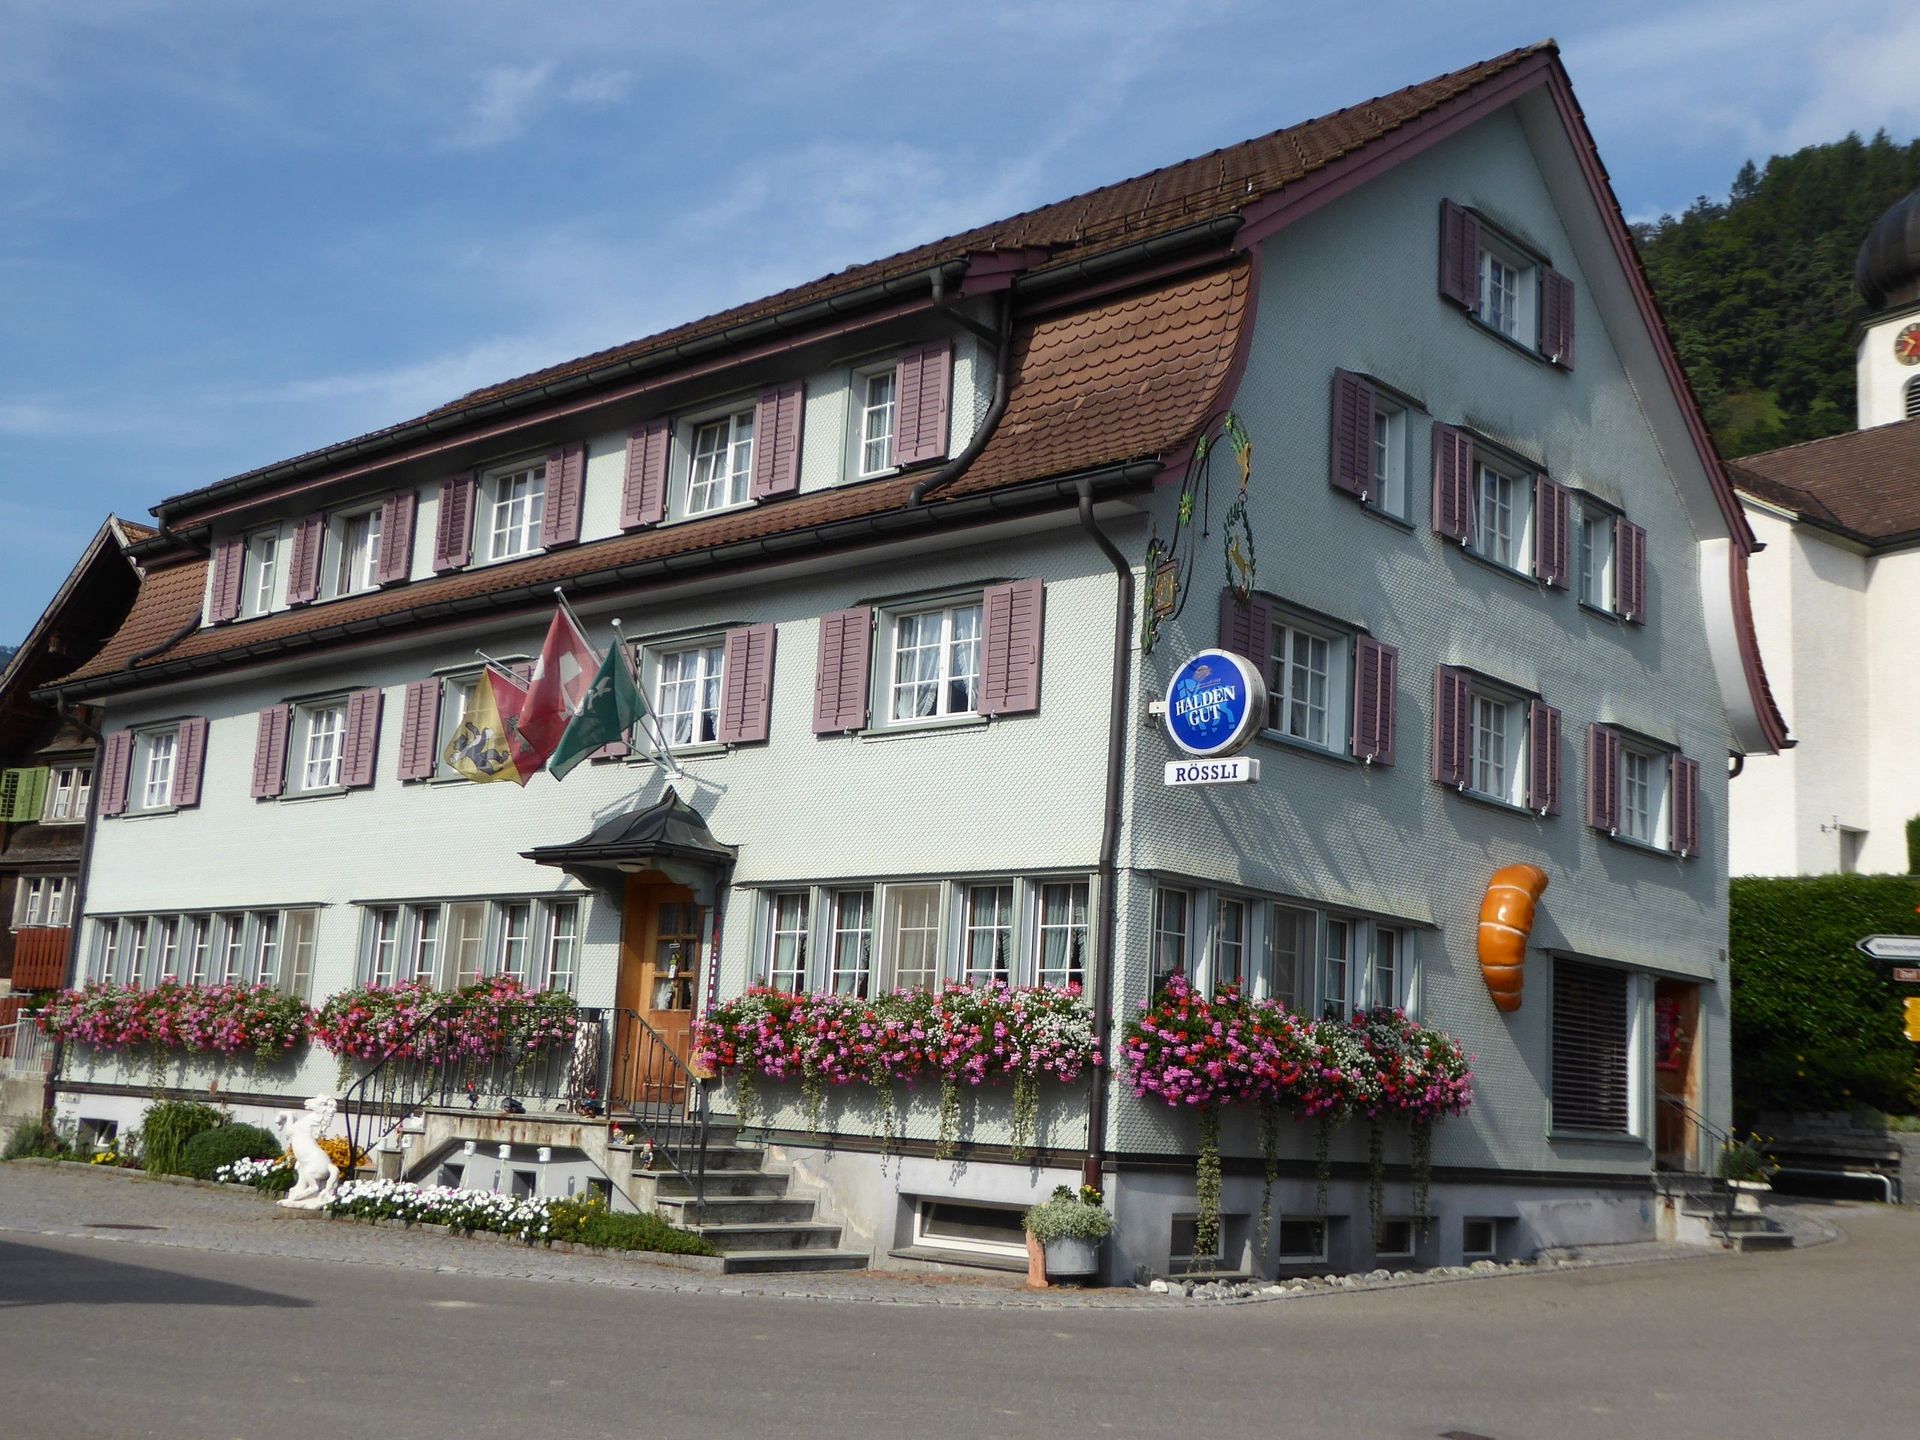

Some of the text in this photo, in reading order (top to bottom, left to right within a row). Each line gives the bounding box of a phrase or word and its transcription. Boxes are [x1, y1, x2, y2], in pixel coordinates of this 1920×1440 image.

[1175, 685, 1236, 716] HALDEN
[1189, 704, 1221, 726] GUT
[1175, 763, 1239, 782] RÖSSLI
